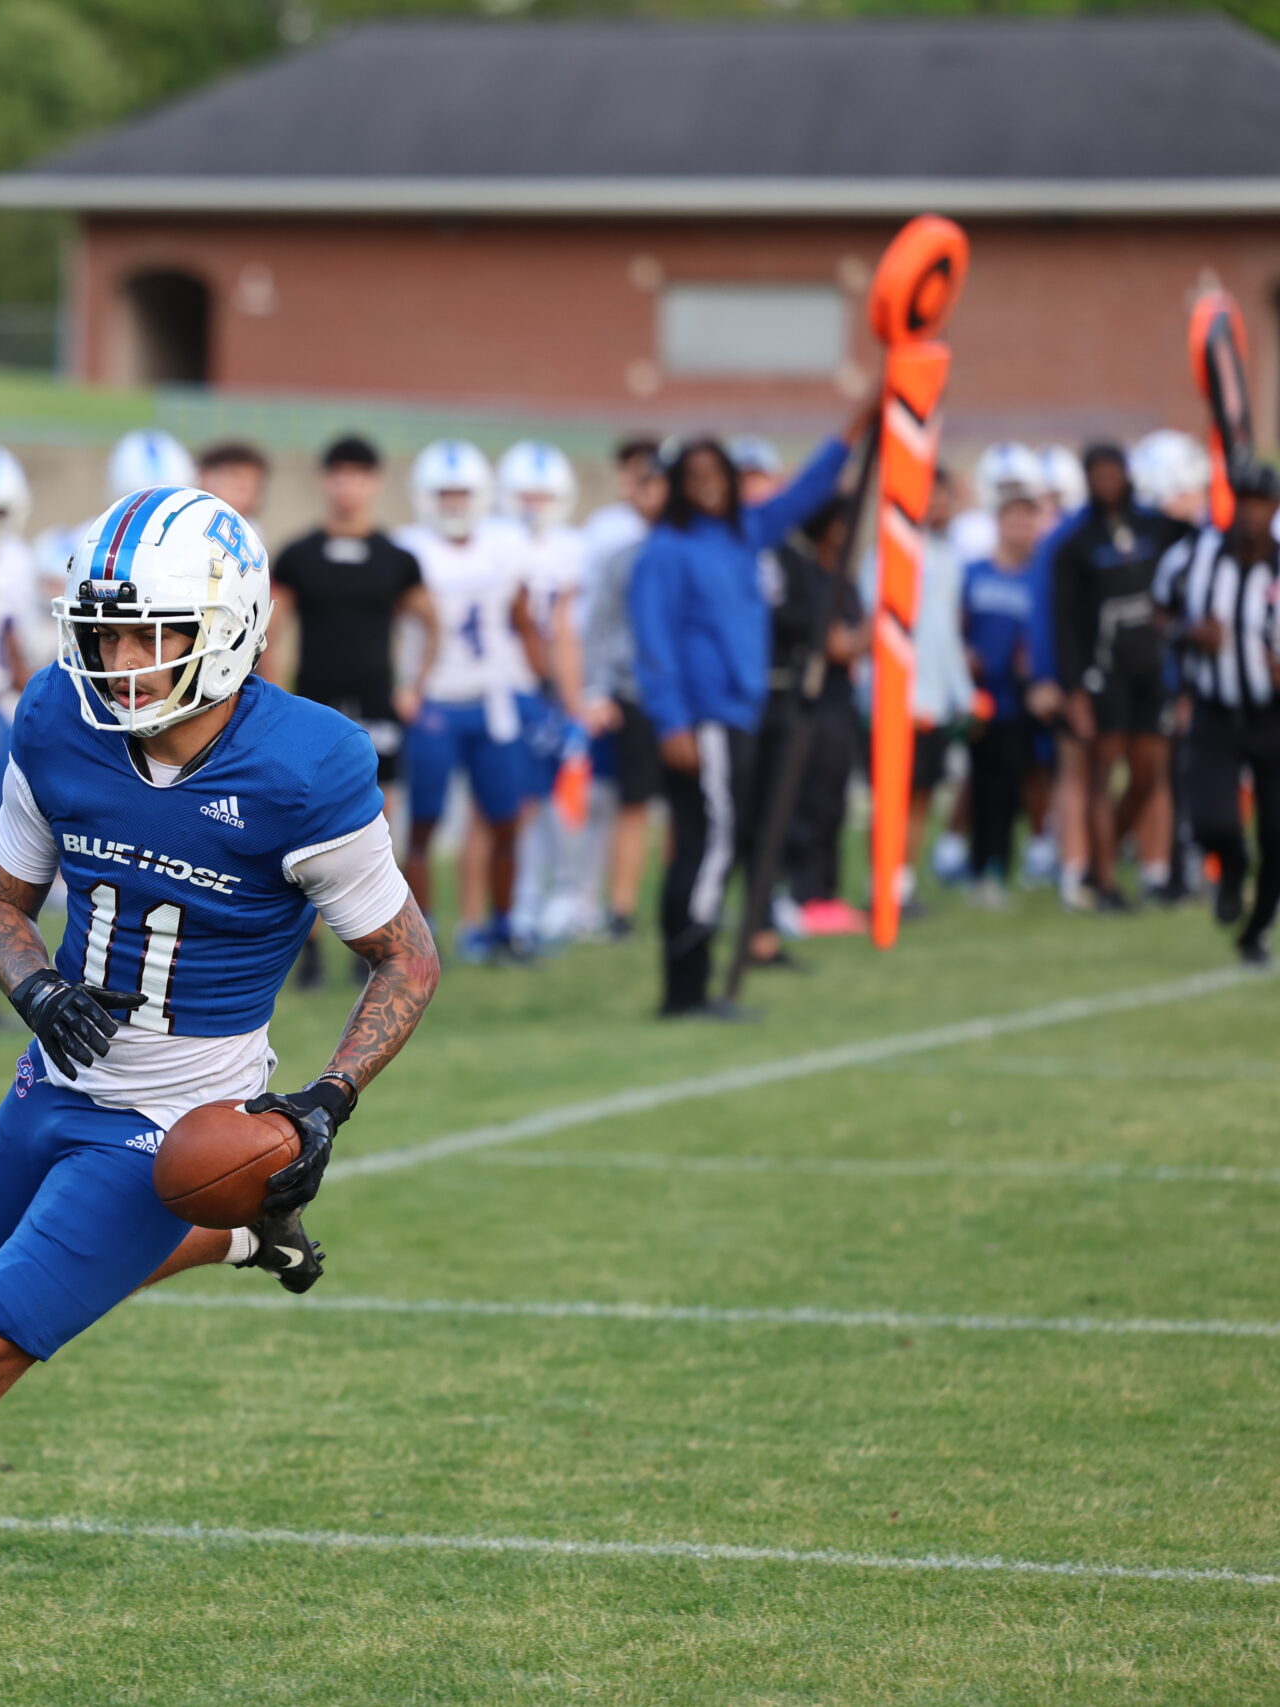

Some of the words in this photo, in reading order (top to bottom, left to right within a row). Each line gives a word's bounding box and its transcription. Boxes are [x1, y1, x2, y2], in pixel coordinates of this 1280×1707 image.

[199, 805, 245, 829] adidas
[62, 833, 135, 866] BLUE
[138, 849, 242, 895] HOSE
[81, 880, 185, 1035] 11
[125, 1138, 159, 1154] adid
